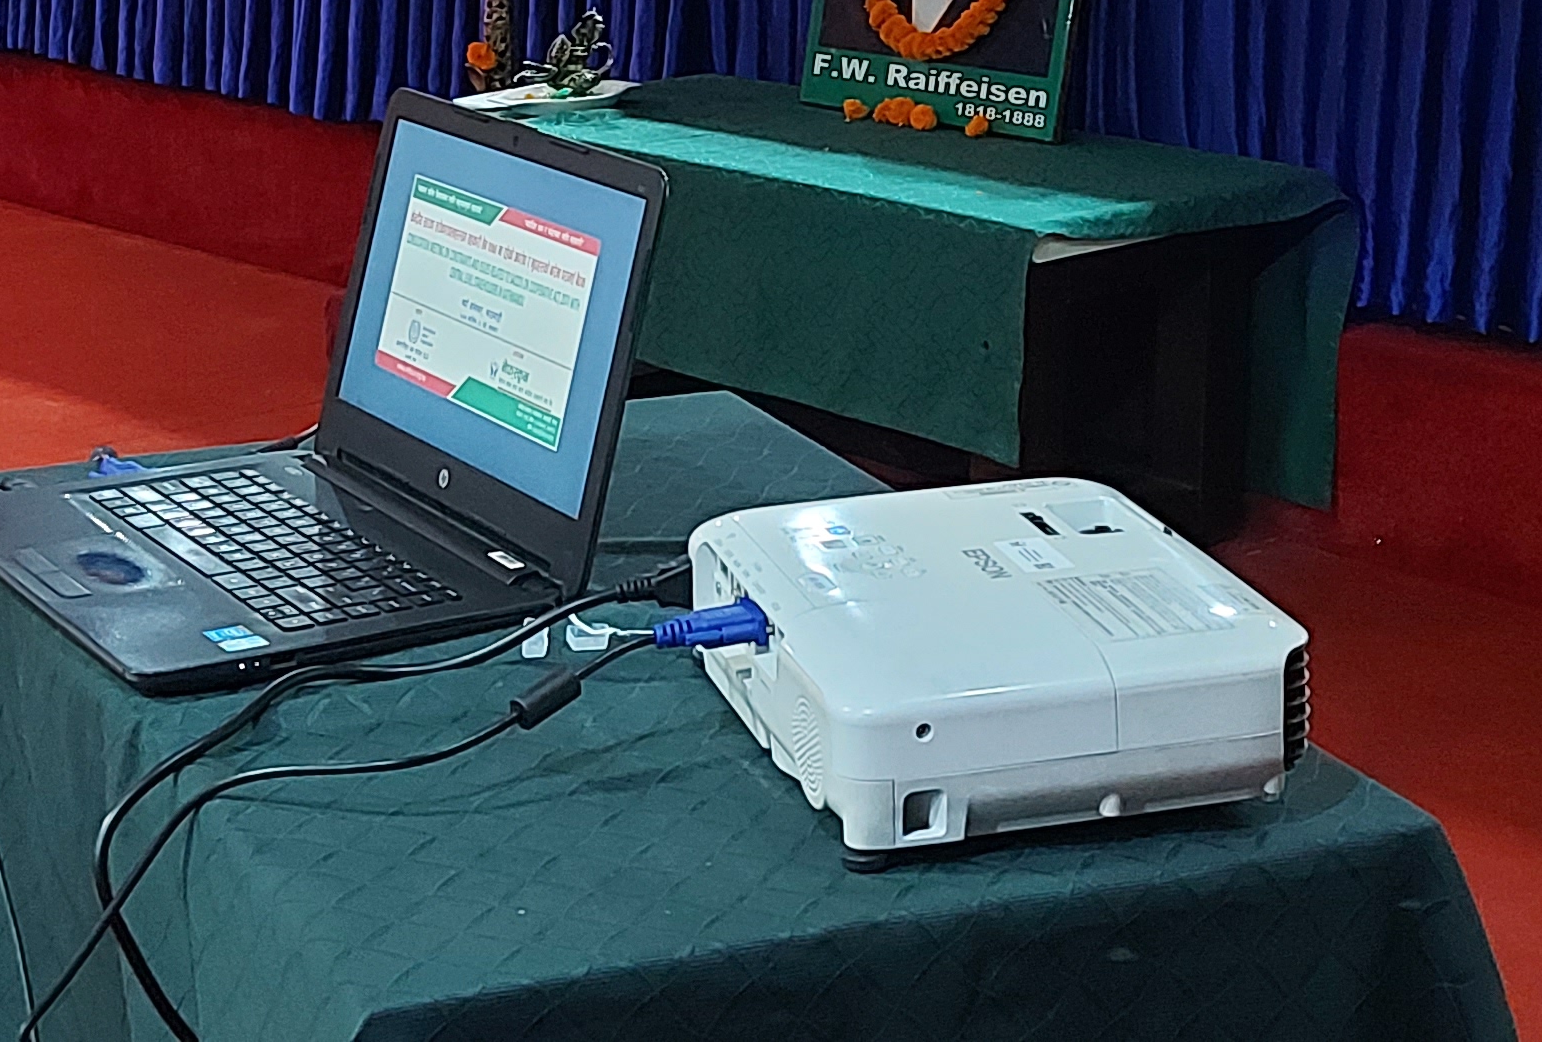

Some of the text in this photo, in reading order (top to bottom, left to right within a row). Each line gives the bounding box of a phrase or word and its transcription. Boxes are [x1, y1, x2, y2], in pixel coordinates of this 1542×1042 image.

[813, 53, 1048, 108] F.W. Raiffeisen
[955, 102, 1045, 128] 1818-1888
[961, 547, 1013, 580] EPSON
